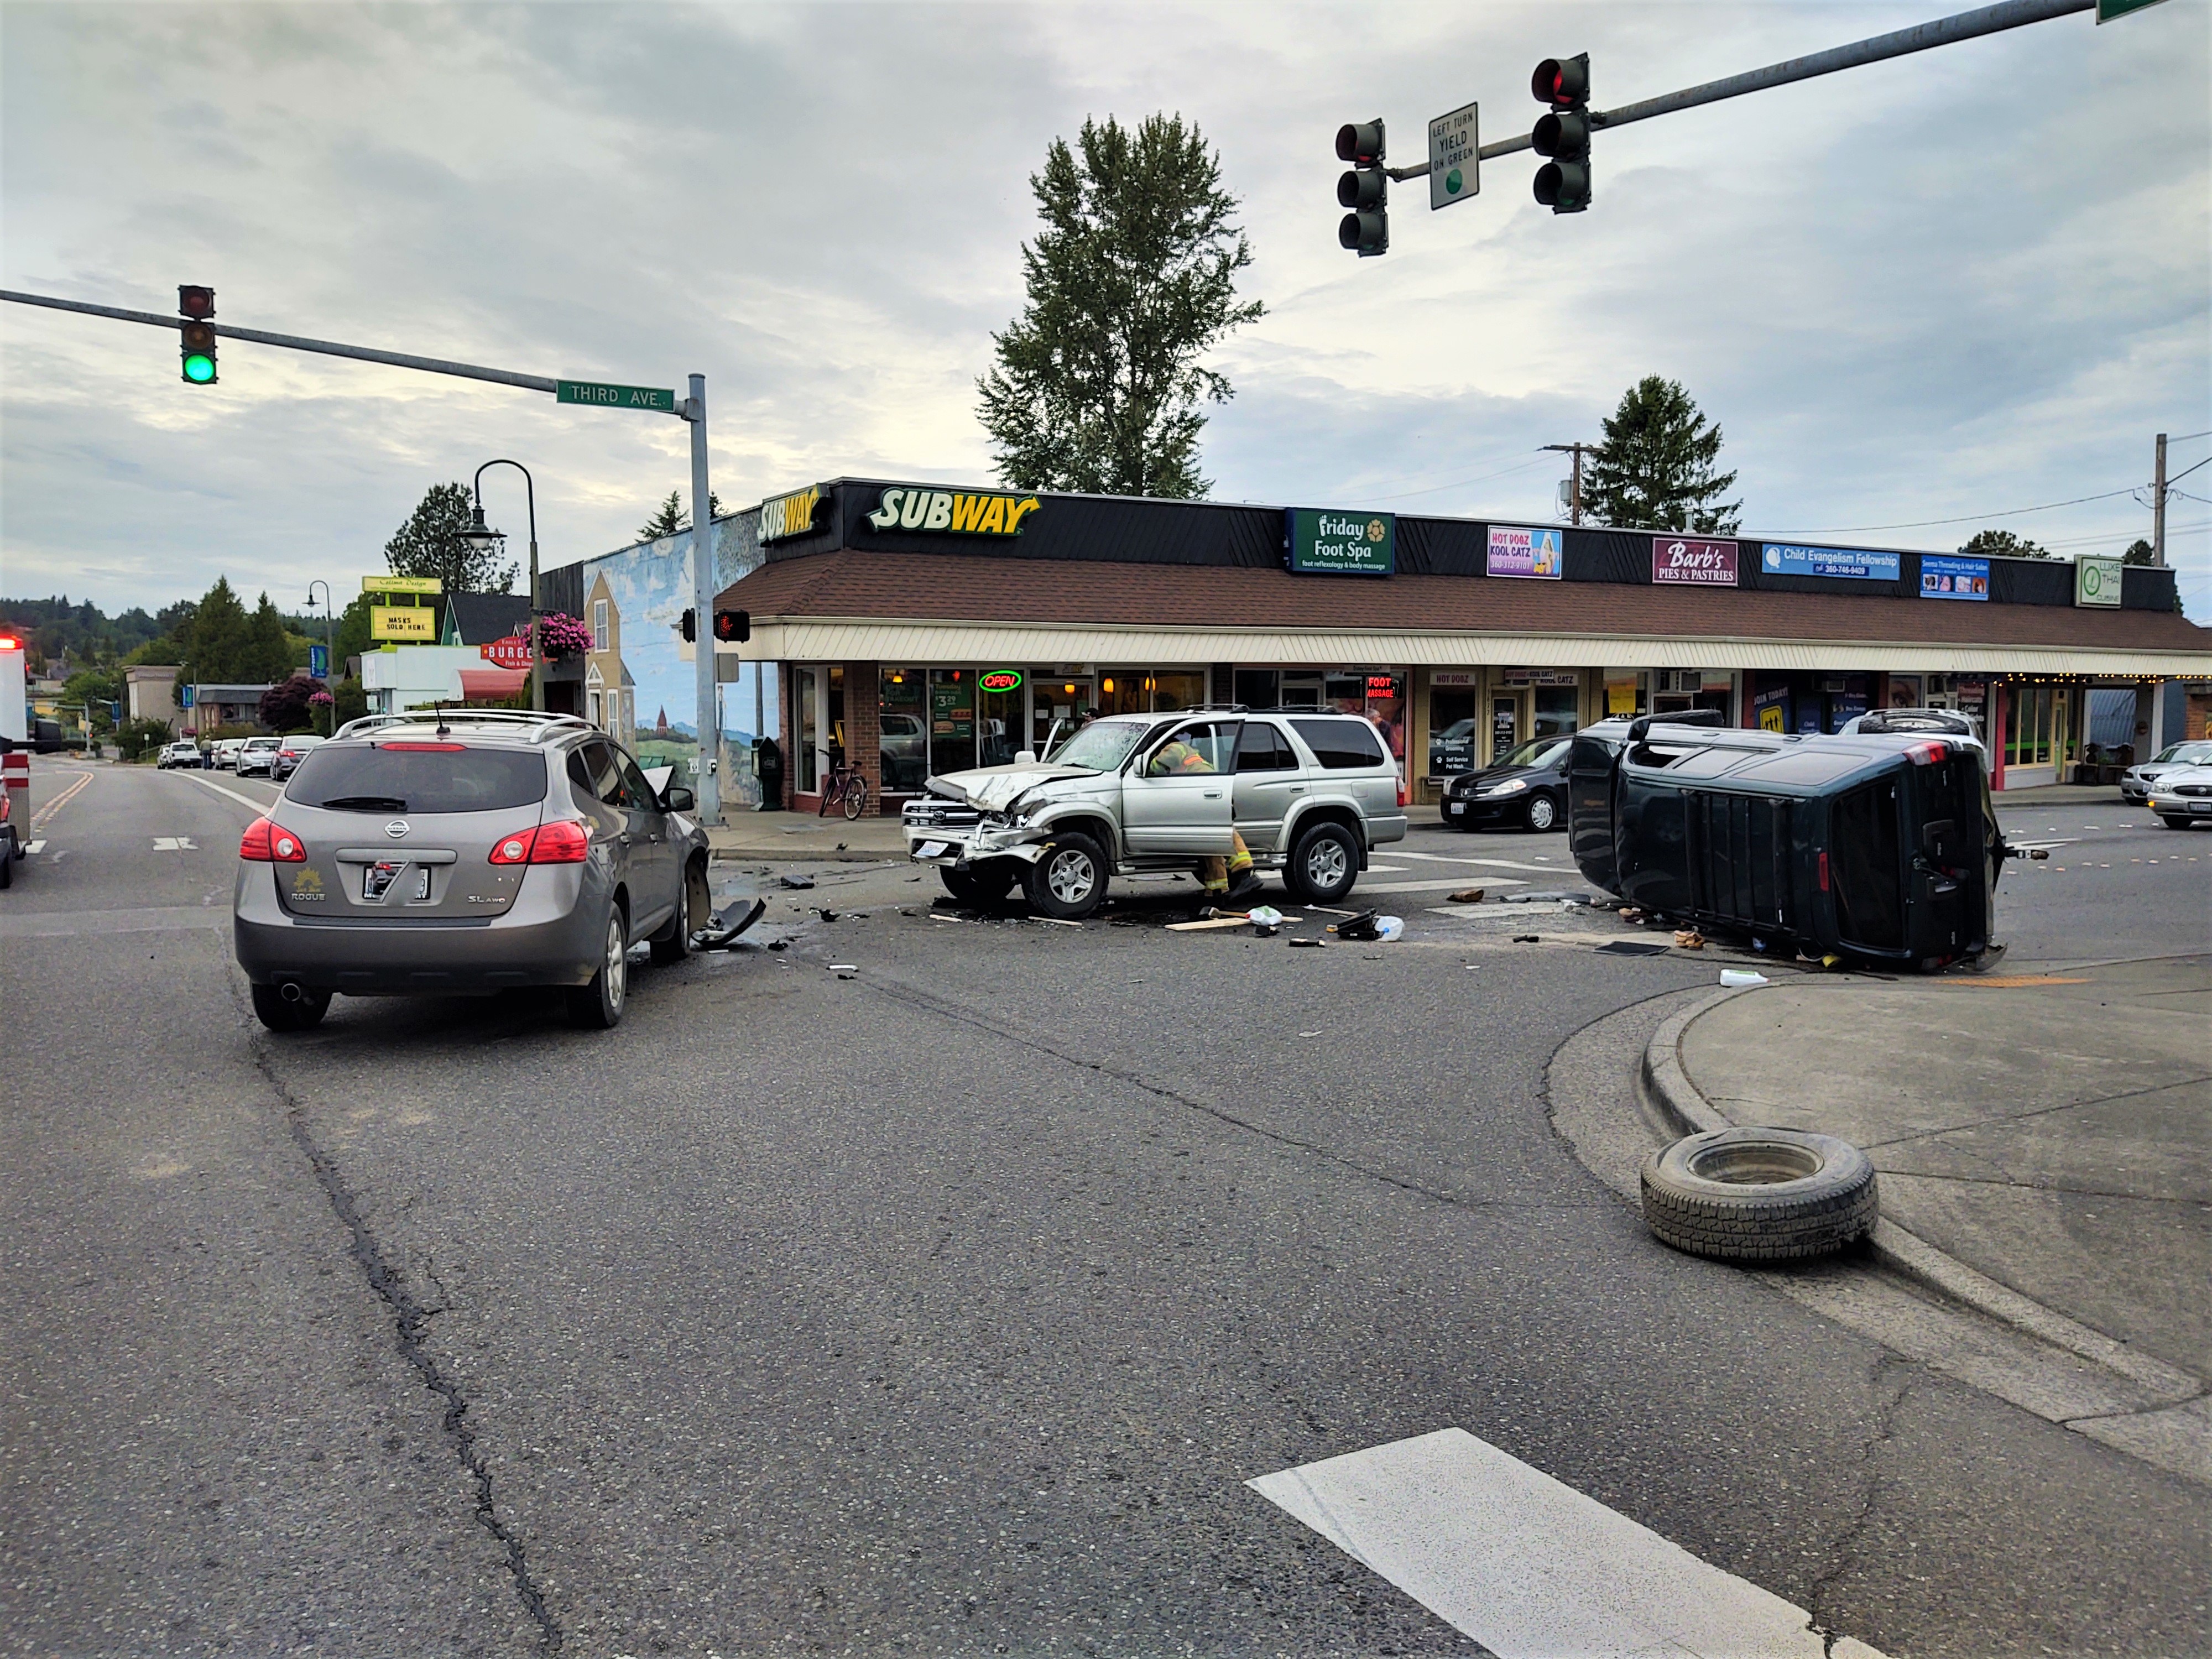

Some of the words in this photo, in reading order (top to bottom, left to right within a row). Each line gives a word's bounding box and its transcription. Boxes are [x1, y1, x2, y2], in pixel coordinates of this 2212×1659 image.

[1433, 121, 1449, 138] LEFT
[1454, 112, 1473, 129] TURN
[1439, 131, 1467, 153] YIELD
[1434, 158, 1444, 171] ON
[1448, 146, 1473, 165] GREEN
[570, 385, 619, 403] THIRD
[630, 390, 662, 406] AVE.
[757, 484, 821, 540] SUBWAY
[869, 487, 1042, 534] SUBWAY
[1318, 515, 1364, 541] Friday
[1492, 533, 1507, 545] HOT
[1314, 540, 1344, 556] Foot
[1347, 541, 1372, 562] Spa
[1490, 545, 1510, 556] KOOL
[1511, 546, 1531, 557] CATZ
[1667, 541, 1724, 570] Barb's
[1783, 547, 1806, 560] Child
[1807, 549, 1855, 565] Evangelism
[1855, 553, 1897, 567] Fellowship
[1314, 560, 1344, 569] reflexology
[1349, 561, 1363, 570] body
[1363, 563, 1386, 571] massage
[1490, 560, 1530, 570] 360-312-9101
[2099, 562, 2121, 572] LUXE
[1658, 567, 1679, 580] PIES
[1681, 569, 1689, 580] &
[1691, 570, 1734, 581] PASTRIES
[488, 646, 533, 659] BURGE
[984, 675, 1015, 687] OPEN
[1368, 677, 1392, 687] FOOT
[1436, 674, 1451, 684] HOT
[1557, 675, 1574, 684] CATZ
[1754, 692, 1767, 706] JOIN
[1767, 687, 1788, 701] TODAY!
[291, 893, 326, 901] ROGUE
